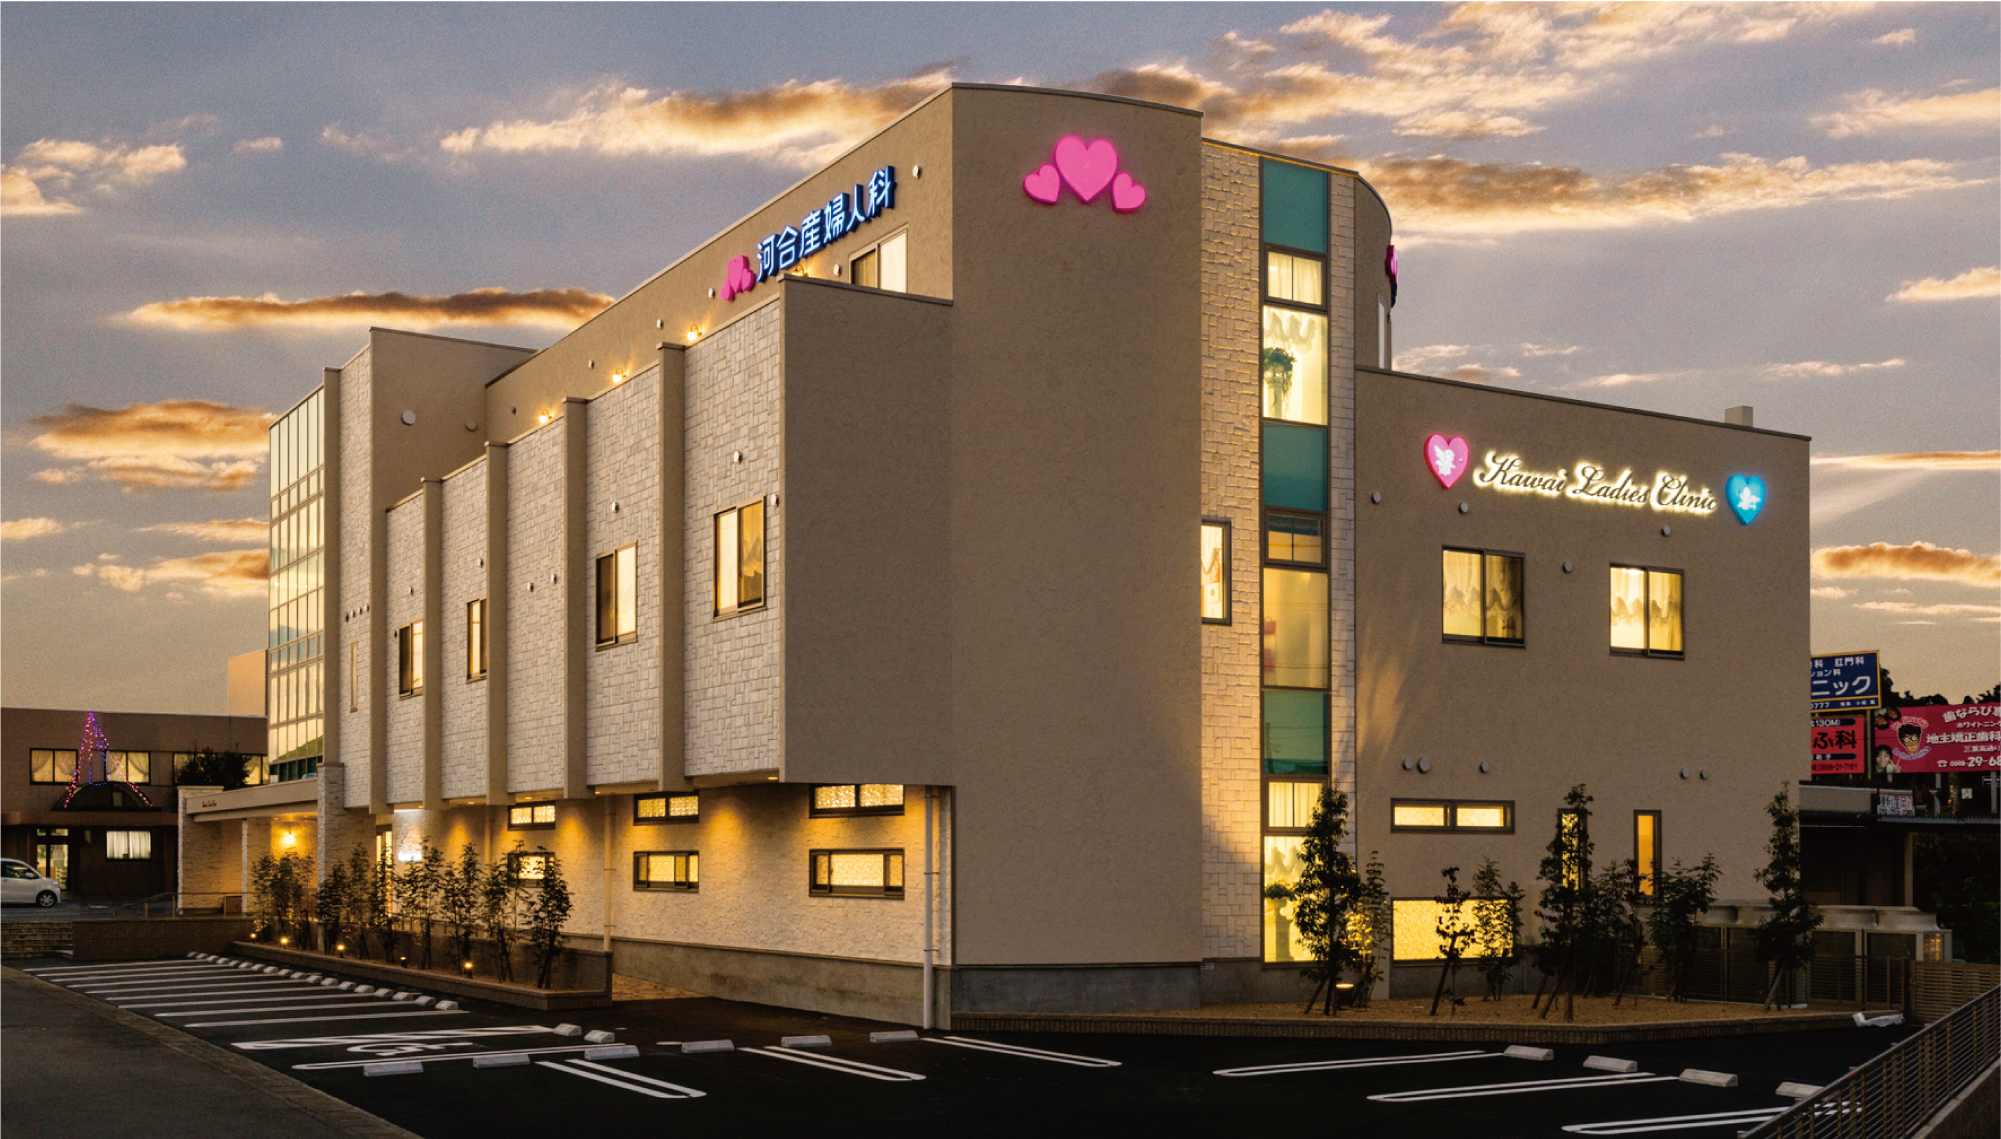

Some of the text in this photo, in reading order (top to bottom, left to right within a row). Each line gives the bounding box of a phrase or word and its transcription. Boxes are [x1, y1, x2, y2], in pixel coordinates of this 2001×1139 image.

[756, 165, 897, 283] 河合産婦人科
[1478, 453, 1717, 511] Kawai Ladies Clinic
